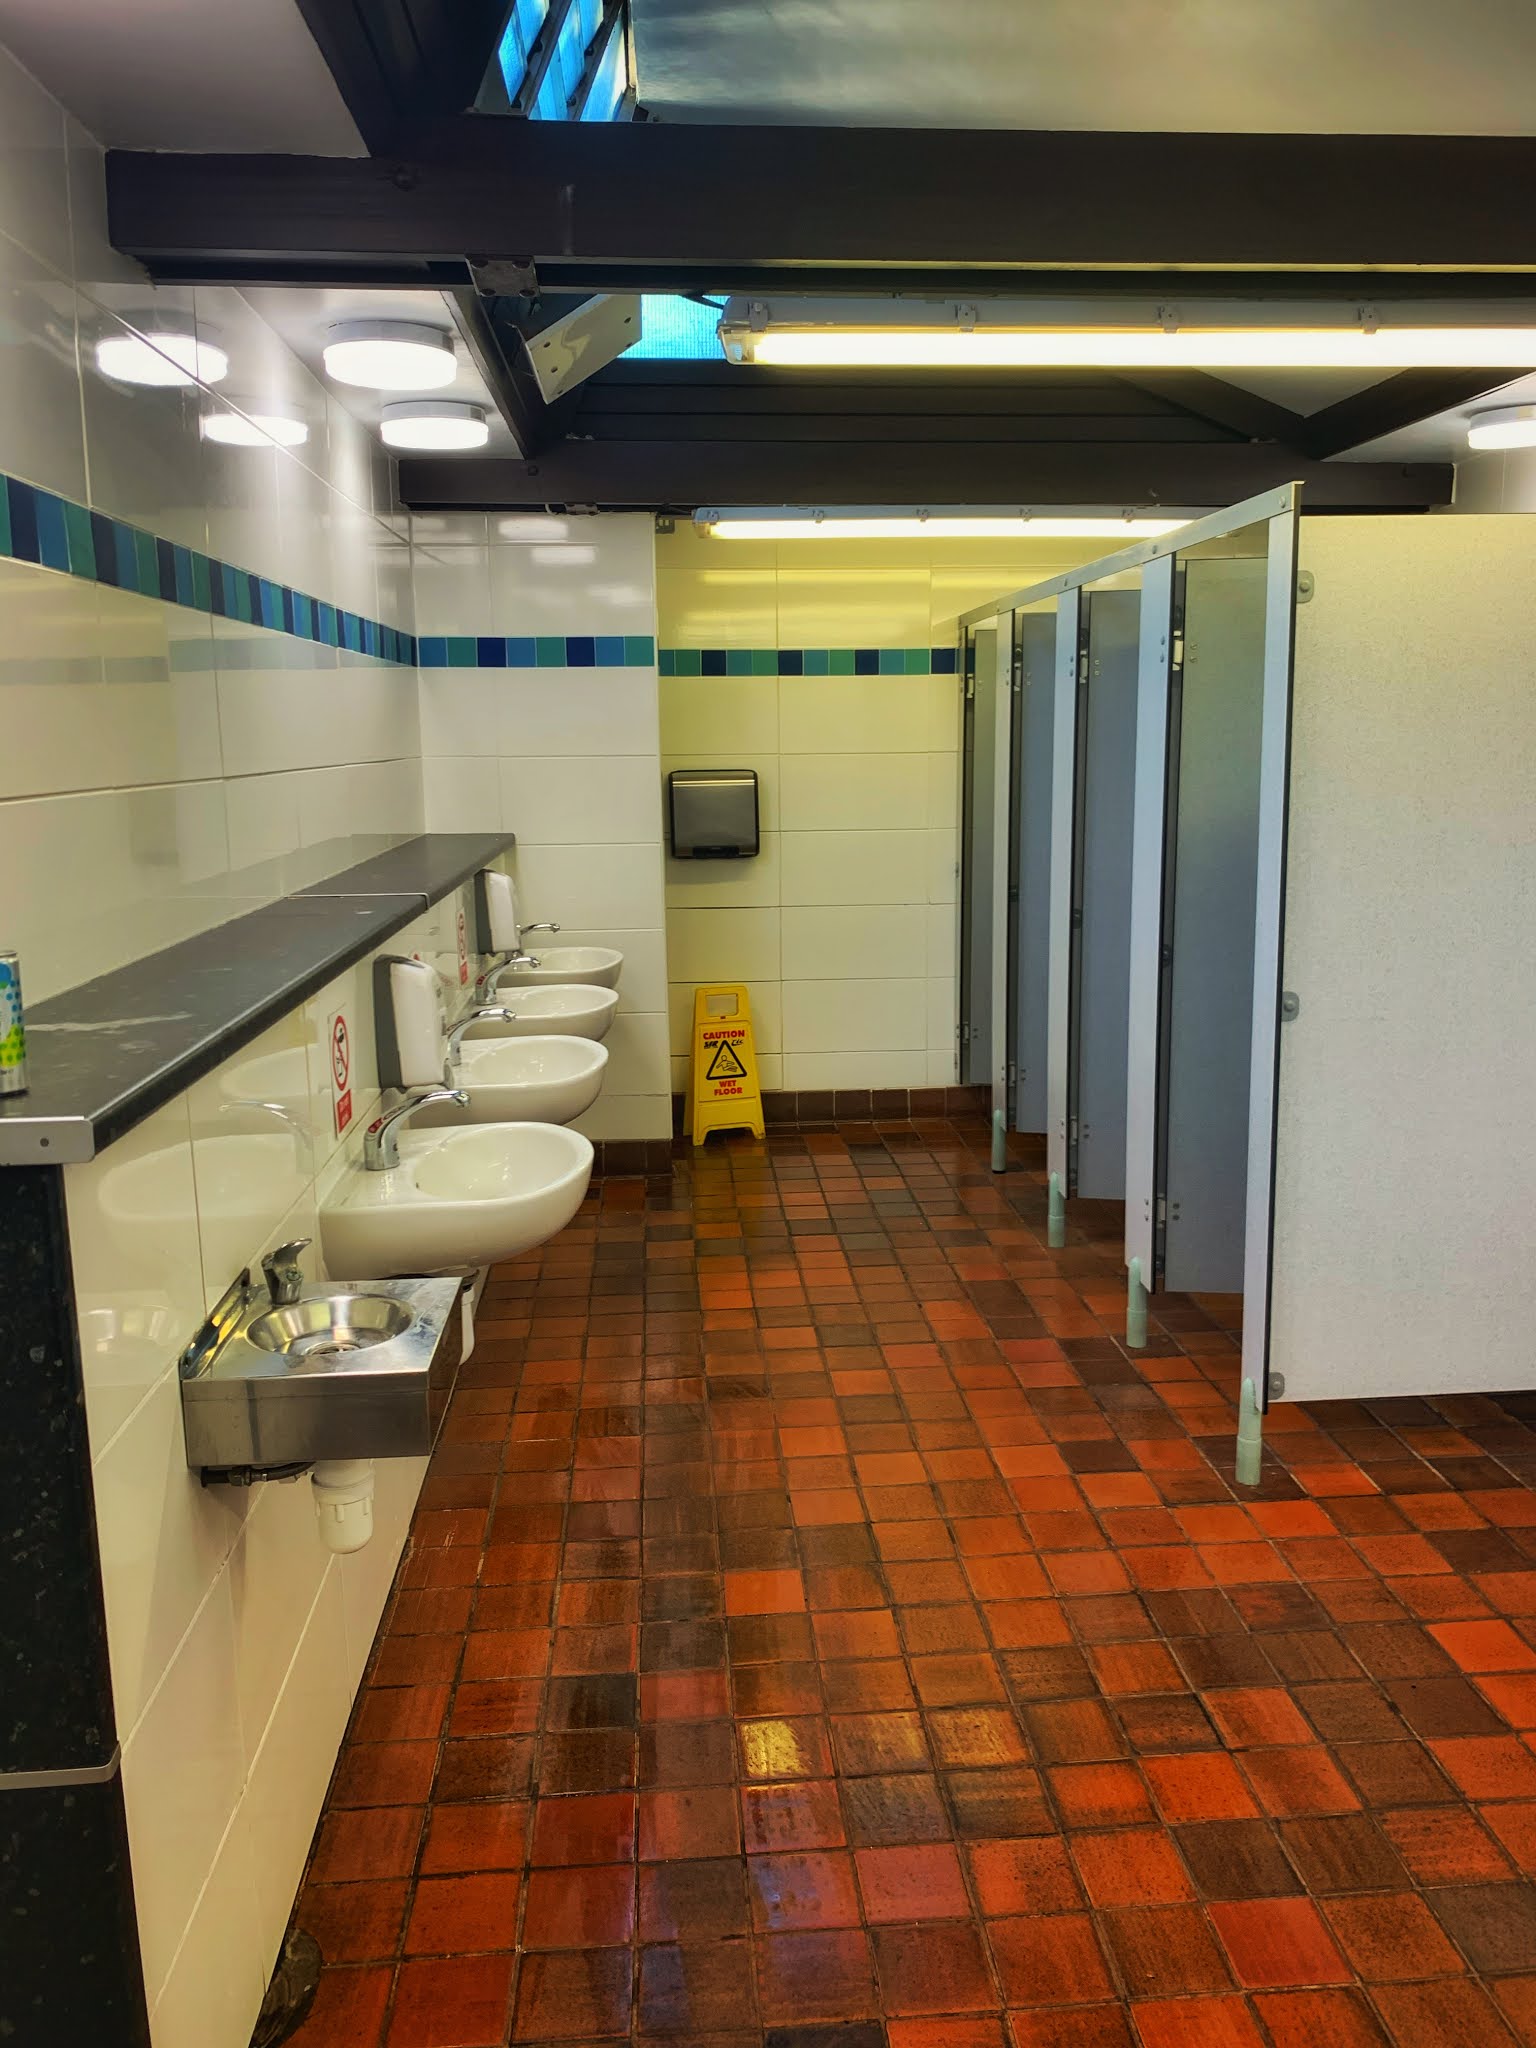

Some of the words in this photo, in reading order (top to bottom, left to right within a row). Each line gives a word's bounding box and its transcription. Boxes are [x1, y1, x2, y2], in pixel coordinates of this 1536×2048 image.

[703, 1030, 745, 1040] CAUTION
[719, 1080, 737, 1088] WET
[714, 1087, 743, 1096] FLOOR
